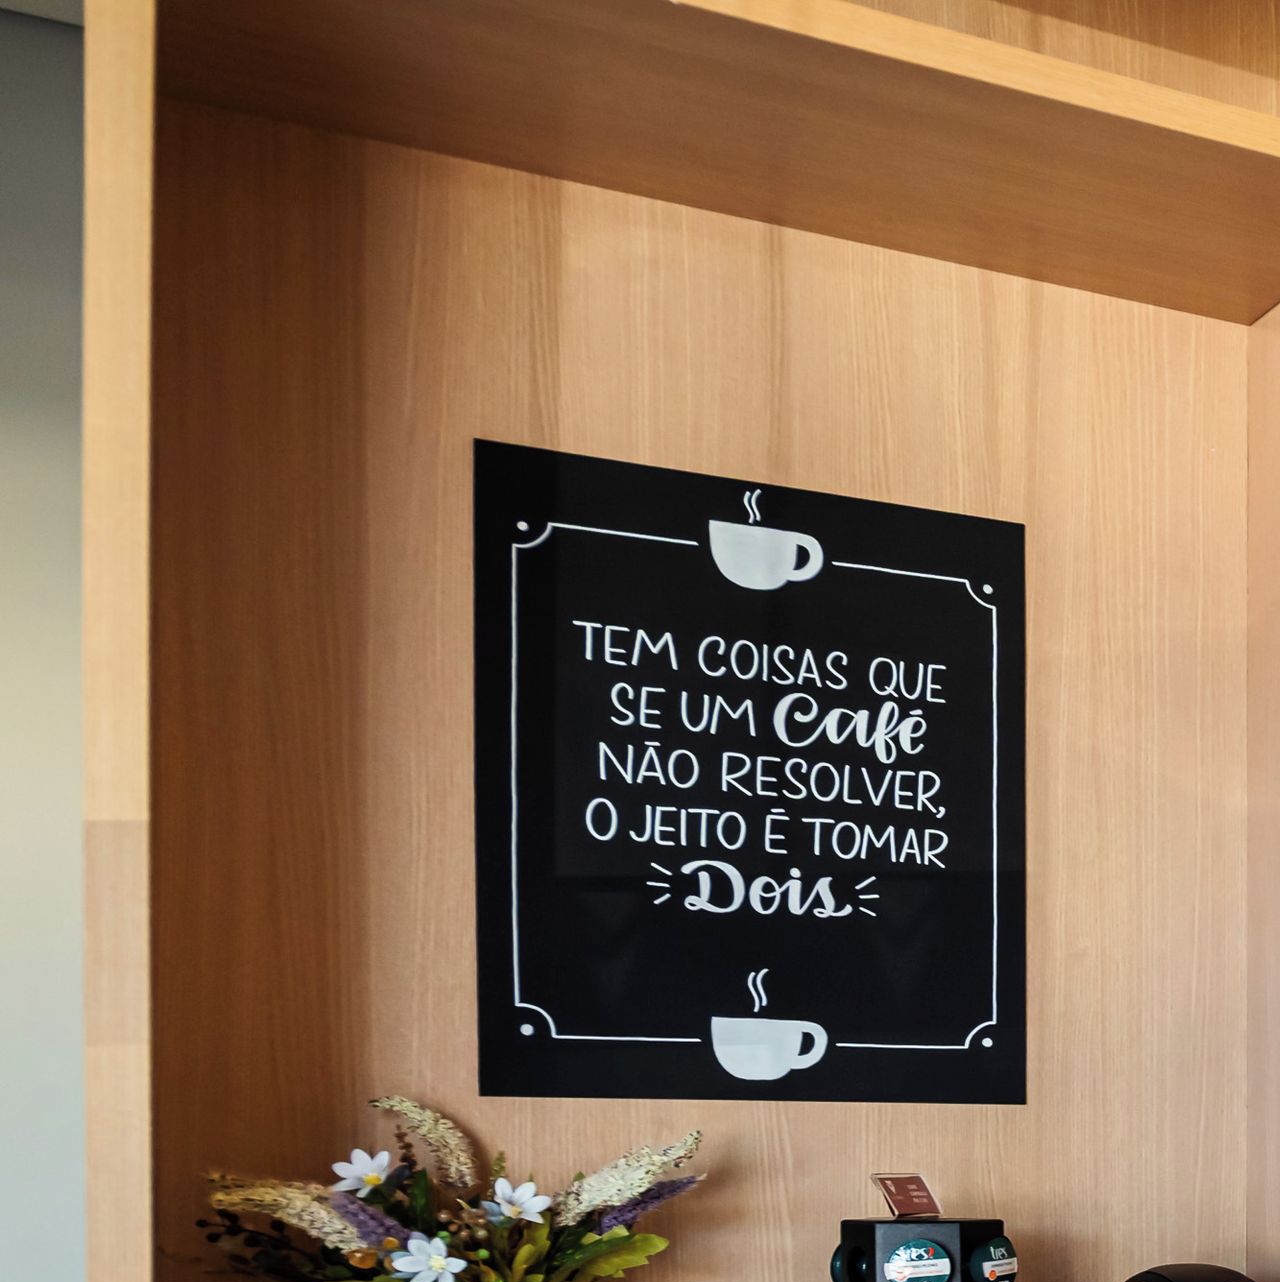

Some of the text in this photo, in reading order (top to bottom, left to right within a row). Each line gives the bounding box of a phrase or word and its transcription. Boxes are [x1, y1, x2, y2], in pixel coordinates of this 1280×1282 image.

[572, 620, 946, 703] TEM COISAS QUE
[610, 682, 928, 765] SE UM Café
[599, 741, 946, 818] NÃO RESOLVER,
[585, 798, 949, 868] O JEITO É TOMAR
[681, 859, 855, 917] Dois
